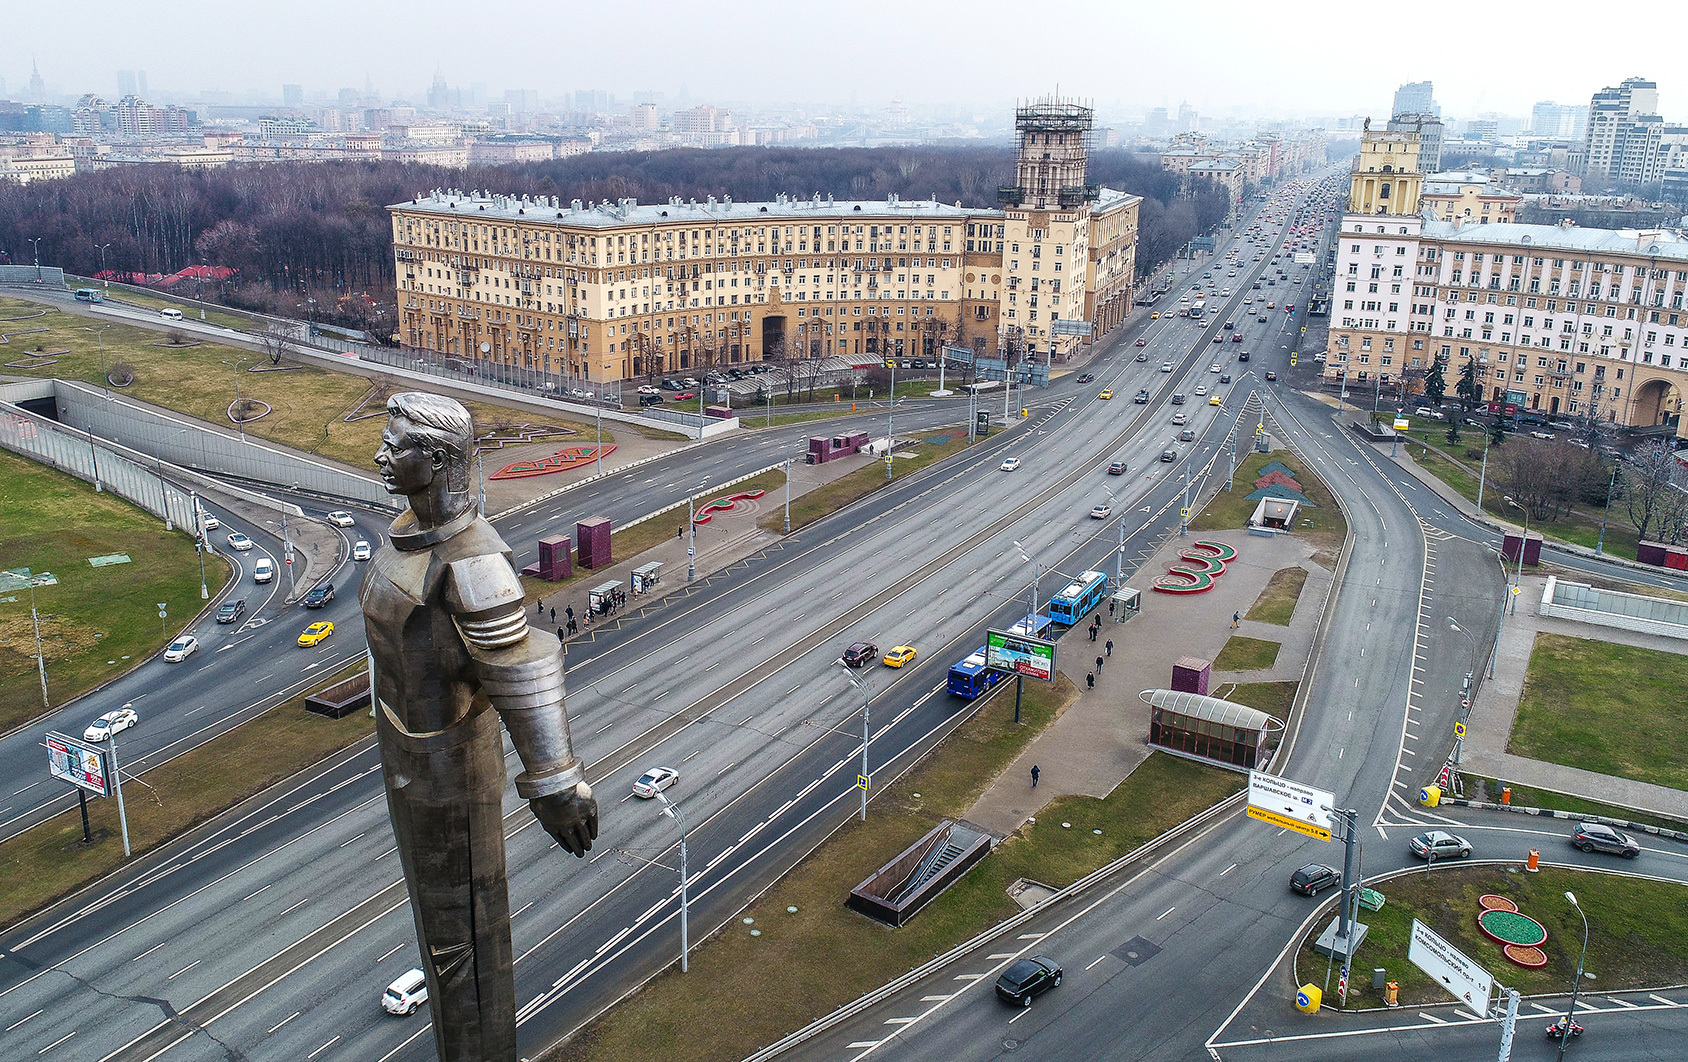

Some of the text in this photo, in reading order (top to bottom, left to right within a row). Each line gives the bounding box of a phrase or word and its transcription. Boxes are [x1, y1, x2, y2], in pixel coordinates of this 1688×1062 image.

[1252, 782, 1292, 799] ВАРШАВСКОЕ
[1262, 777, 1286, 788] КОЛЬЦО
[1290, 786, 1314, 796] направо
[1249, 809, 1266, 817] РУМЕР
[1266, 814, 1295, 827] мебельный
[1295, 825, 1310, 833] центр
[1414, 934, 1462, 974] КОМСОМОЛЬСКИЙ
[1462, 971, 1475, 983] пр-т
[1424, 932, 1447, 952] КОЛЬЦО
[1449, 952, 1469, 969] налево
